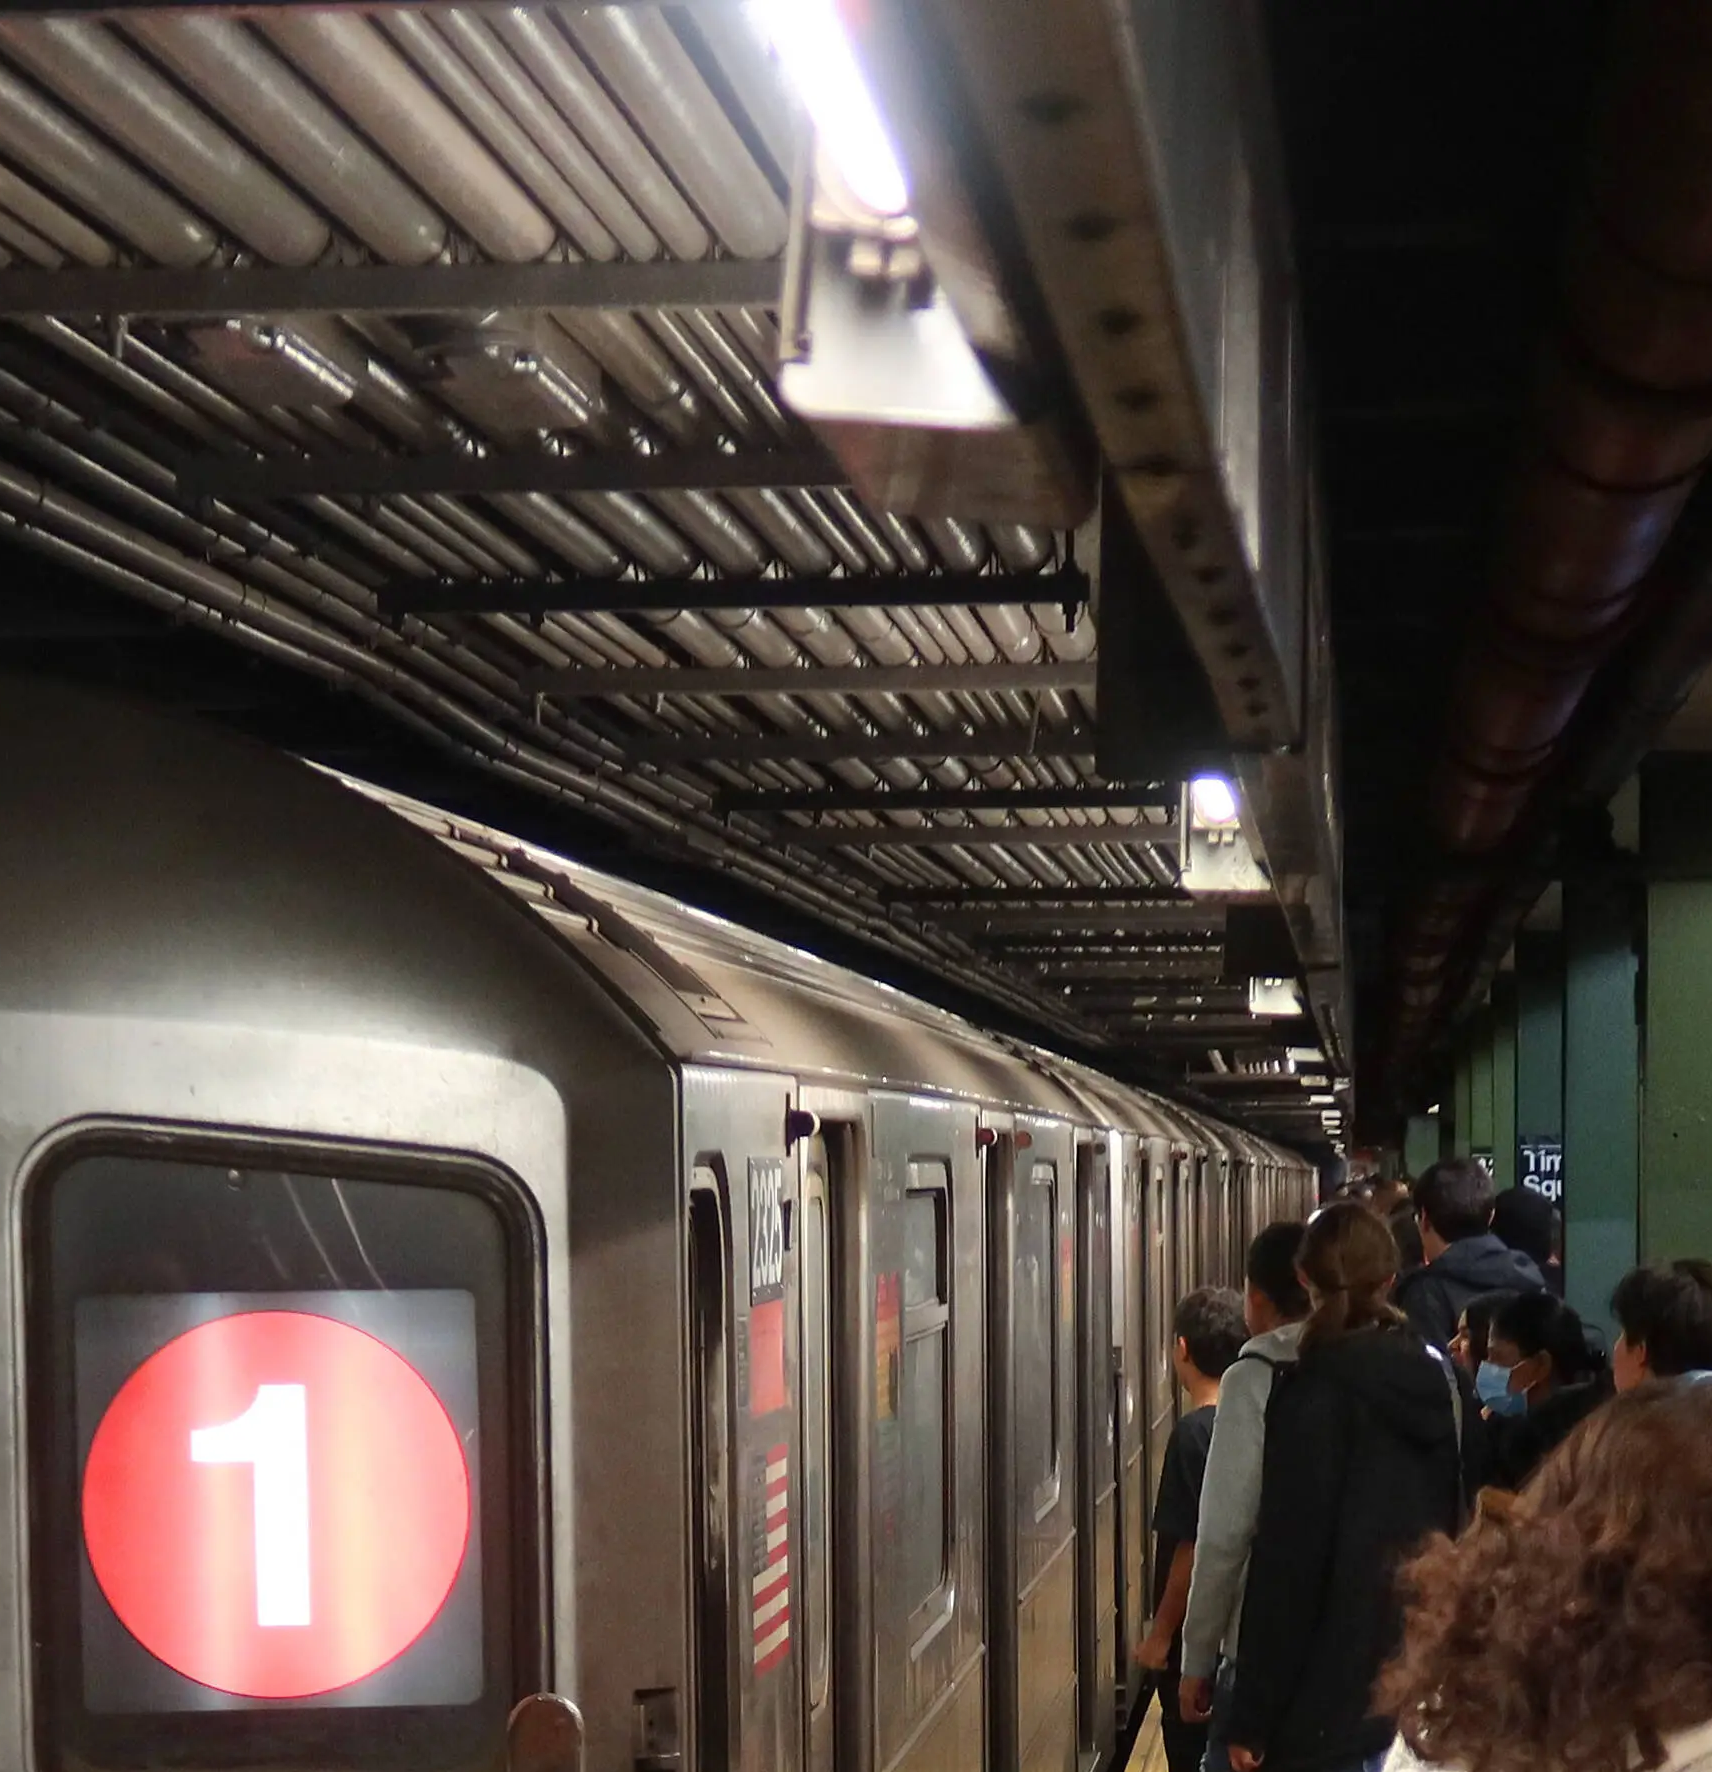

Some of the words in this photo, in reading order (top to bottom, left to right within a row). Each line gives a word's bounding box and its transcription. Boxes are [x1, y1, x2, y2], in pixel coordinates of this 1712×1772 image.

[1523, 1149, 1562, 1172] Tim
[751, 1168, 783, 1288] 2325
[191, 1384, 311, 1626] 1
